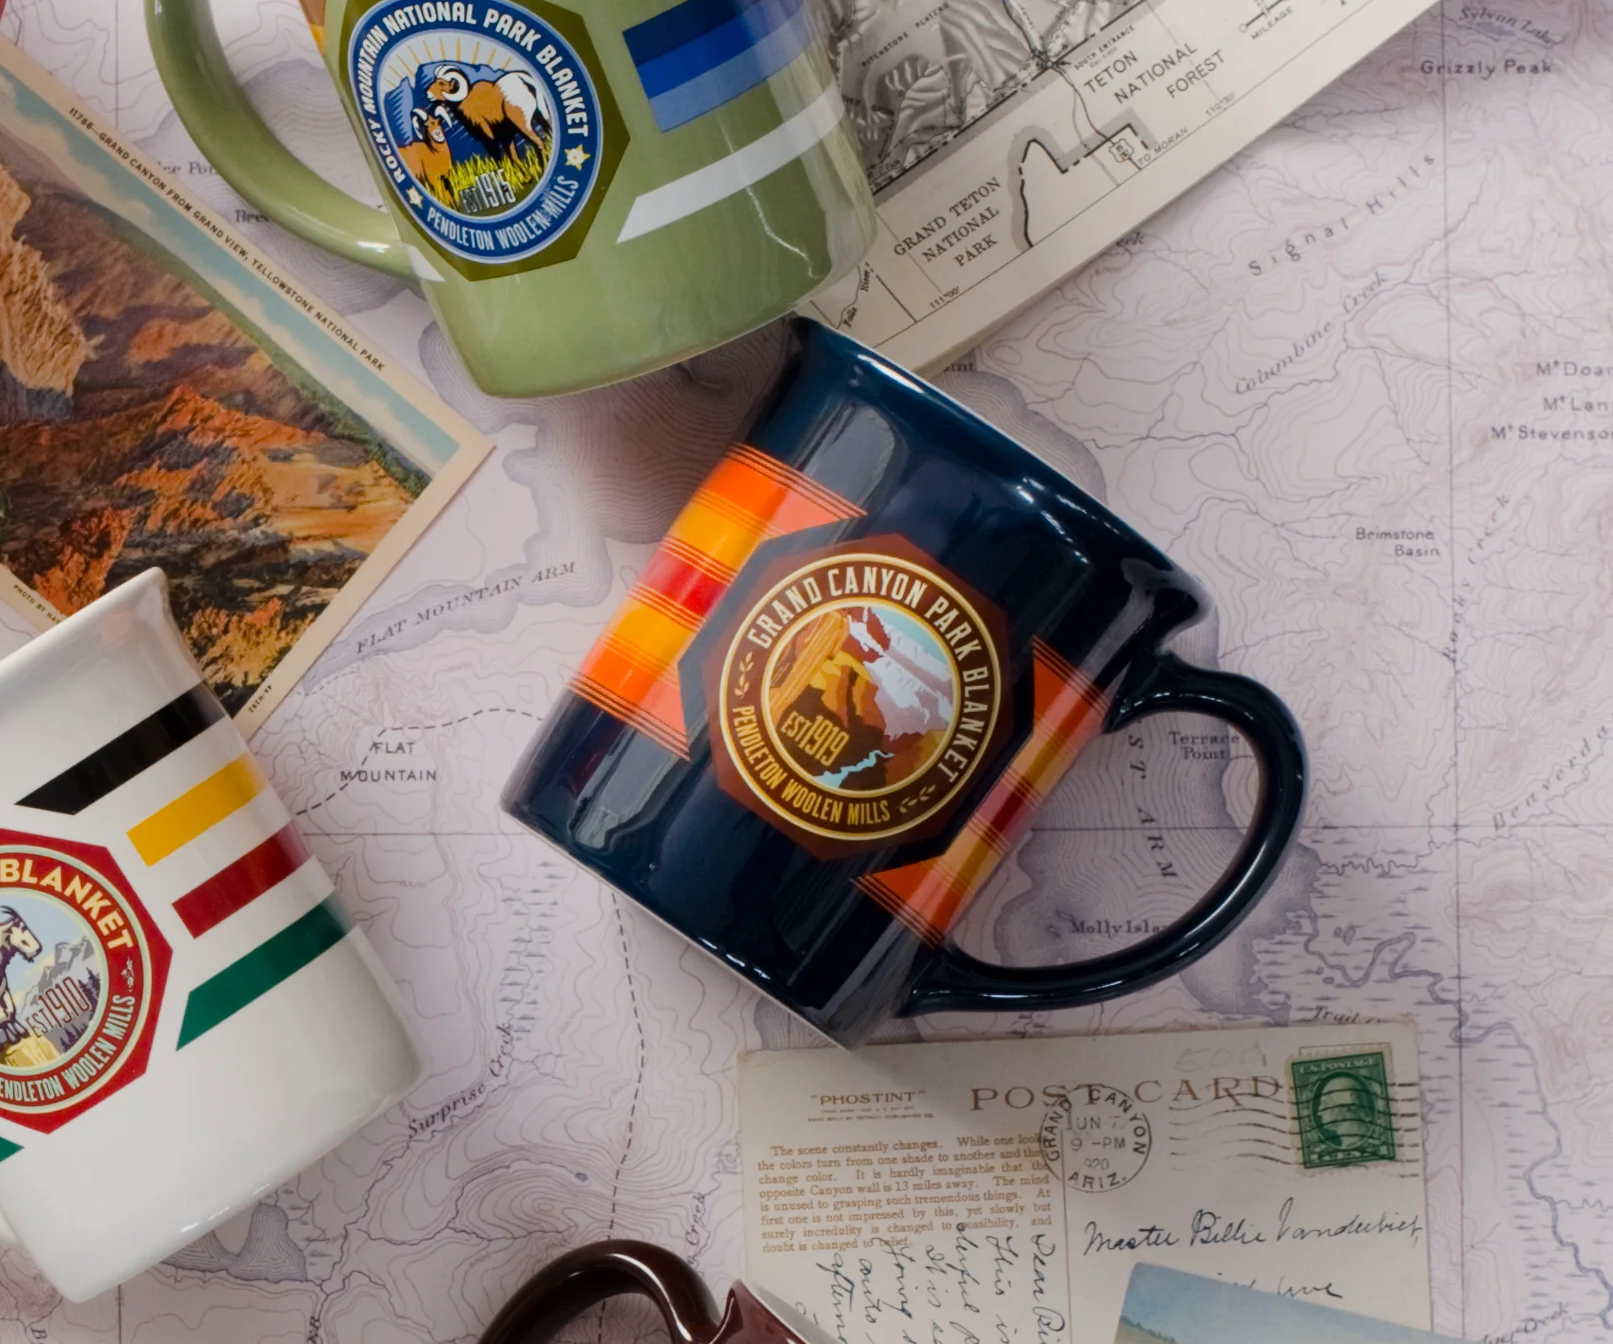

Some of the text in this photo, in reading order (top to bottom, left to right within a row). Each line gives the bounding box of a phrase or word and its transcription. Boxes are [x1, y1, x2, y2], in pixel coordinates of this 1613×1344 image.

[1251, 6, 1294, 41] MILEAGE
[357, 2, 589, 184] ROCKY MOUNTAIN NATIONAL PARK BLANKET
[1083, 50, 1138, 93] TETON
[1113, 42, 1197, 104] NATIONAL
[1166, 49, 1226, 99] FOREST
[1421, 59, 1552, 80] Grizzly Peak
[1137, 126, 1189, 168] TO MORAN
[427, 175, 579, 251] PENDLETON WOOLEN MILLS
[894, 176, 1002, 257] GRAND TETON
[921, 207, 1000, 263] NATIONAL
[130, 158, 166, 191] CANYON
[167, 189, 192, 213] FROM
[193, 210, 224, 239] GRAND
[252, 258, 314, 314] YELLOWSTONE
[315, 312, 359, 351] NATIONAL
[360, 349, 386, 371] PARK
[953, 233, 999, 267] PARK
[1355, 528, 1435, 542] Brimstone
[1394, 545, 1440, 557] Basin
[356, 562, 577, 654] FLAT MOUNTAIN ARM
[747, 566, 990, 783] GRAND CANYON PARK BLANKET
[375, 742, 415, 753] FLAT
[732, 704, 890, 826] PENDLETON WOOLEN MILLS
[340, 770, 437, 782] MOUNTAIN
[61, 1037, 118, 1090] WOOLEN
[102, 994, 136, 1040] MILLS
[1134, 1075, 1282, 1107] CARD
[771, 1136, 989, 1156] The scene constantly changes. While
[1042, 1087, 1146, 1162] GRAND CANYON
